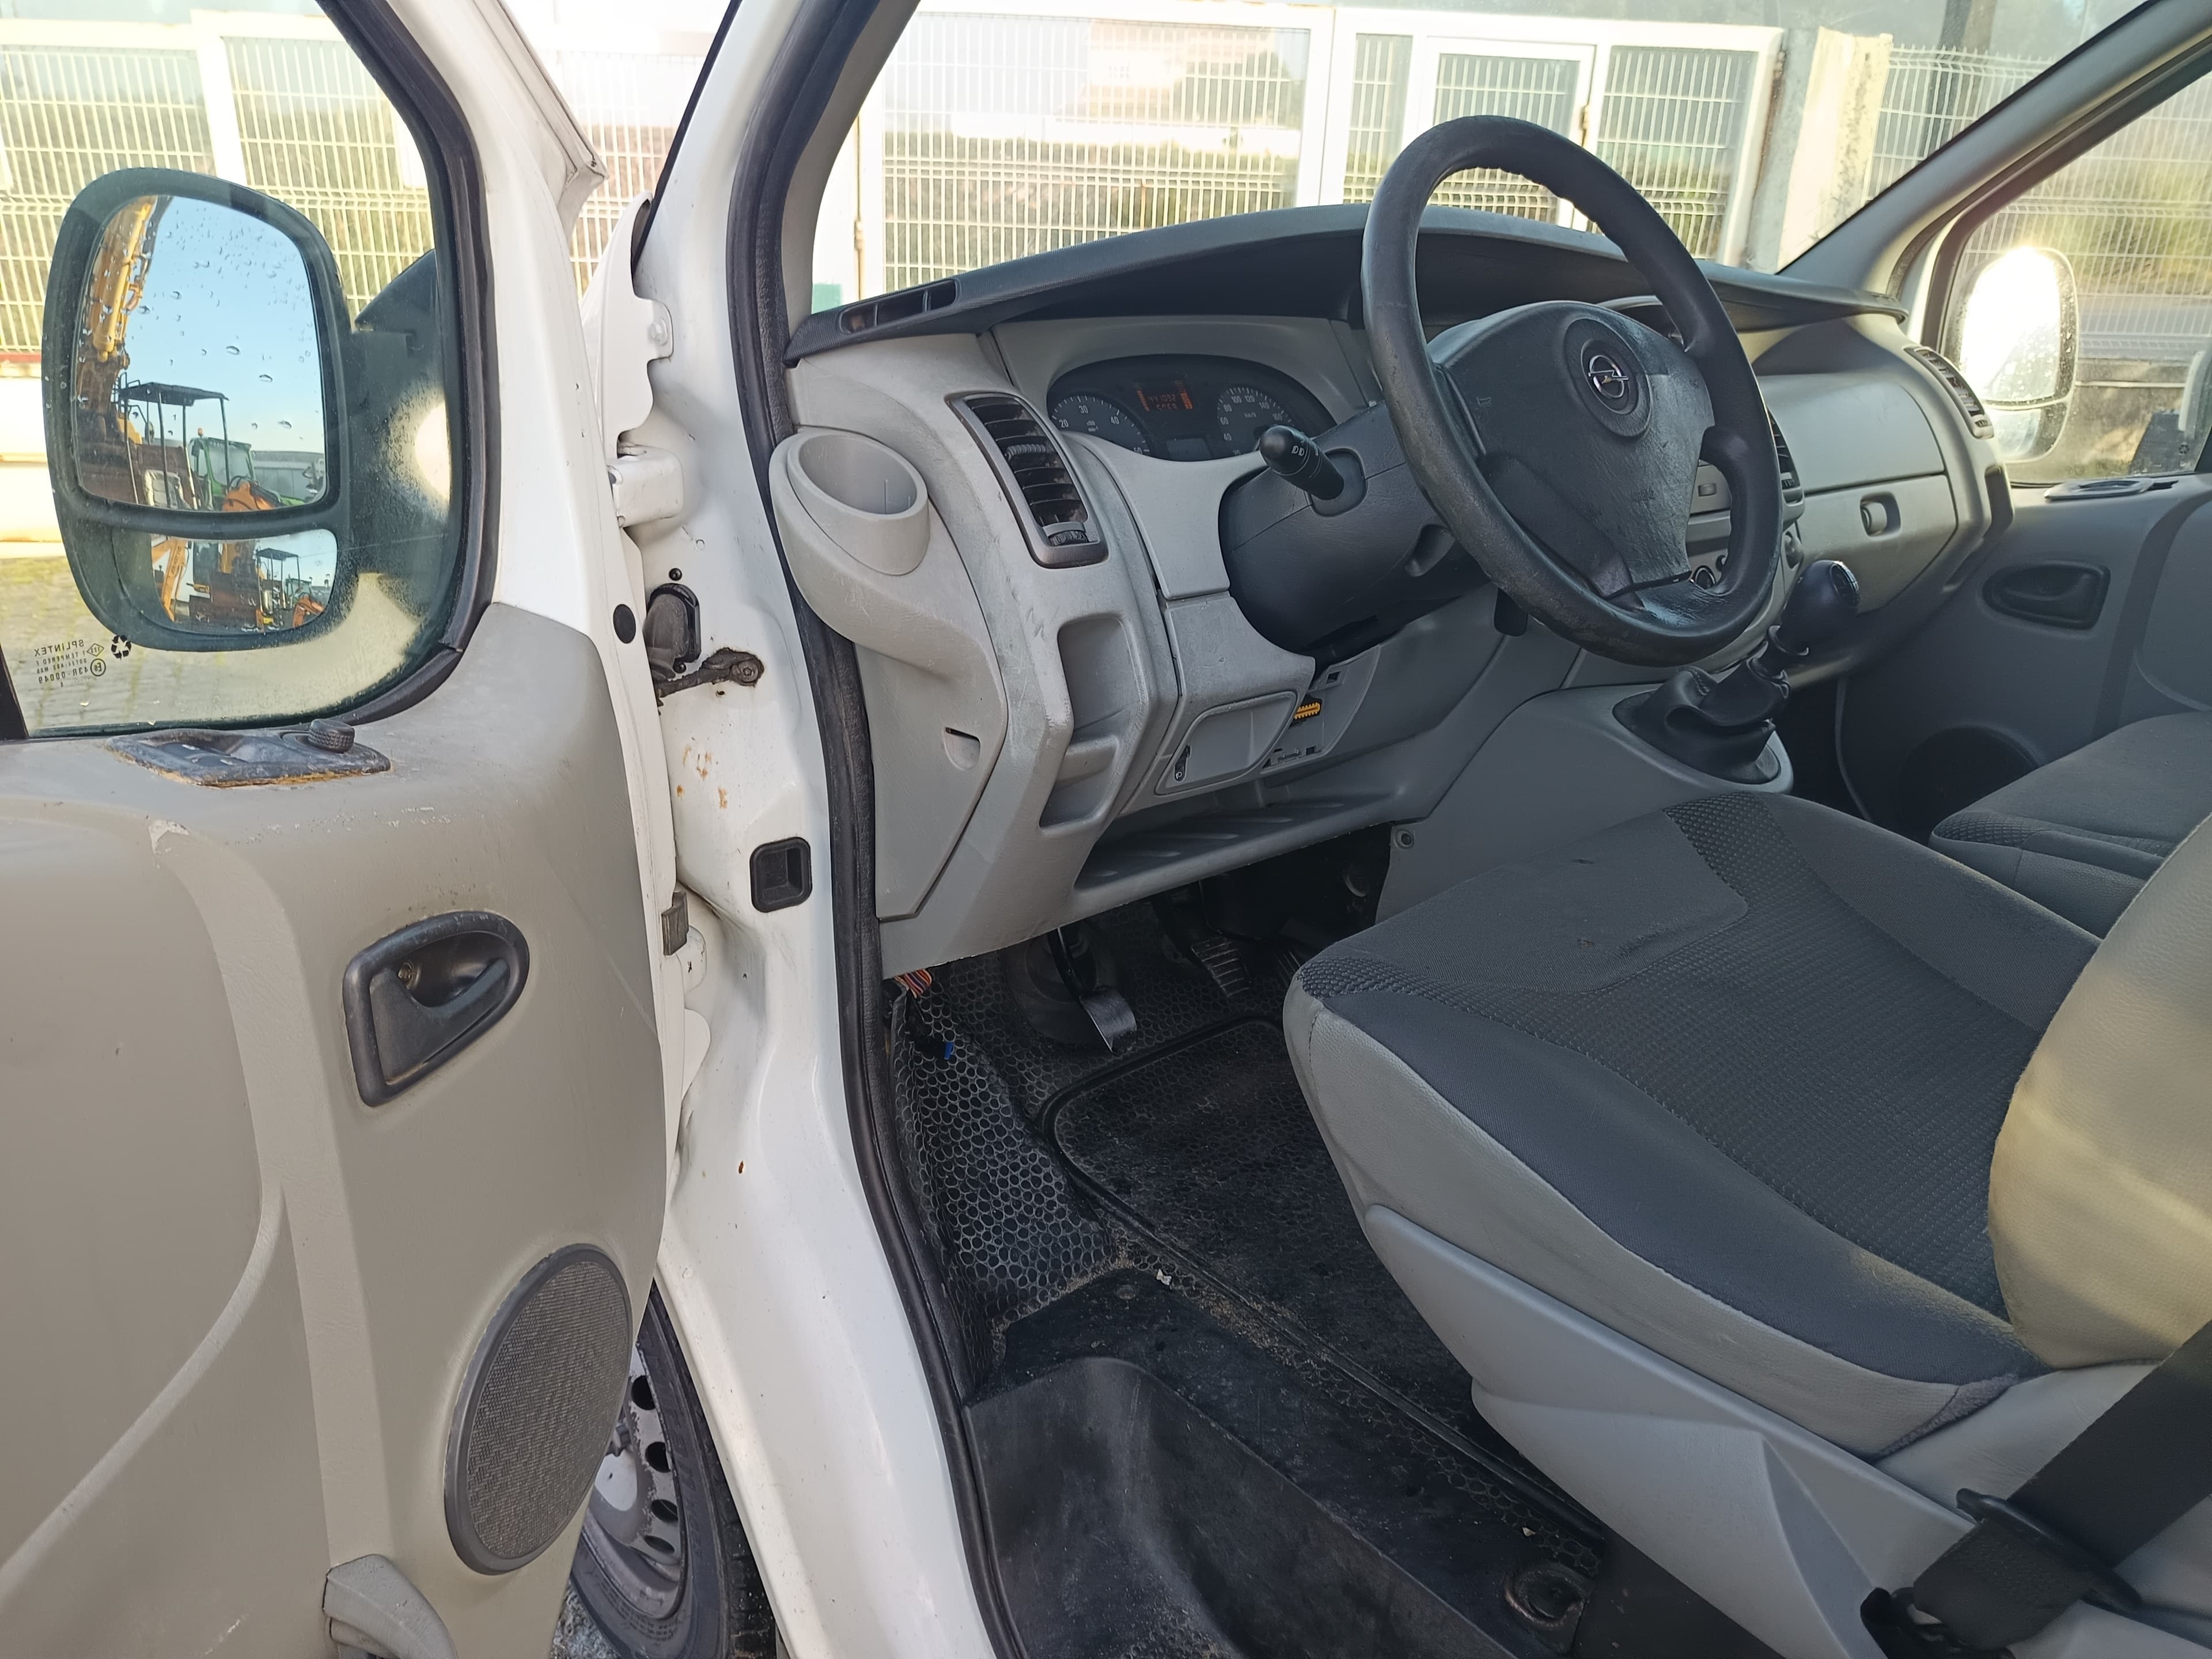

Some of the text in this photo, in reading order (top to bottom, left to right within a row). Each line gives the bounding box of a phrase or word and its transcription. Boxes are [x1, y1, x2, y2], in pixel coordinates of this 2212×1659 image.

[1079, 405, 1089, 414] 30
[1224, 404, 1232, 412] 80
[1059, 419, 1069, 428] 20
[1111, 416, 1120, 425] 40
[1220, 417, 1229, 425] 60
[1224, 433, 1232, 441] 40
